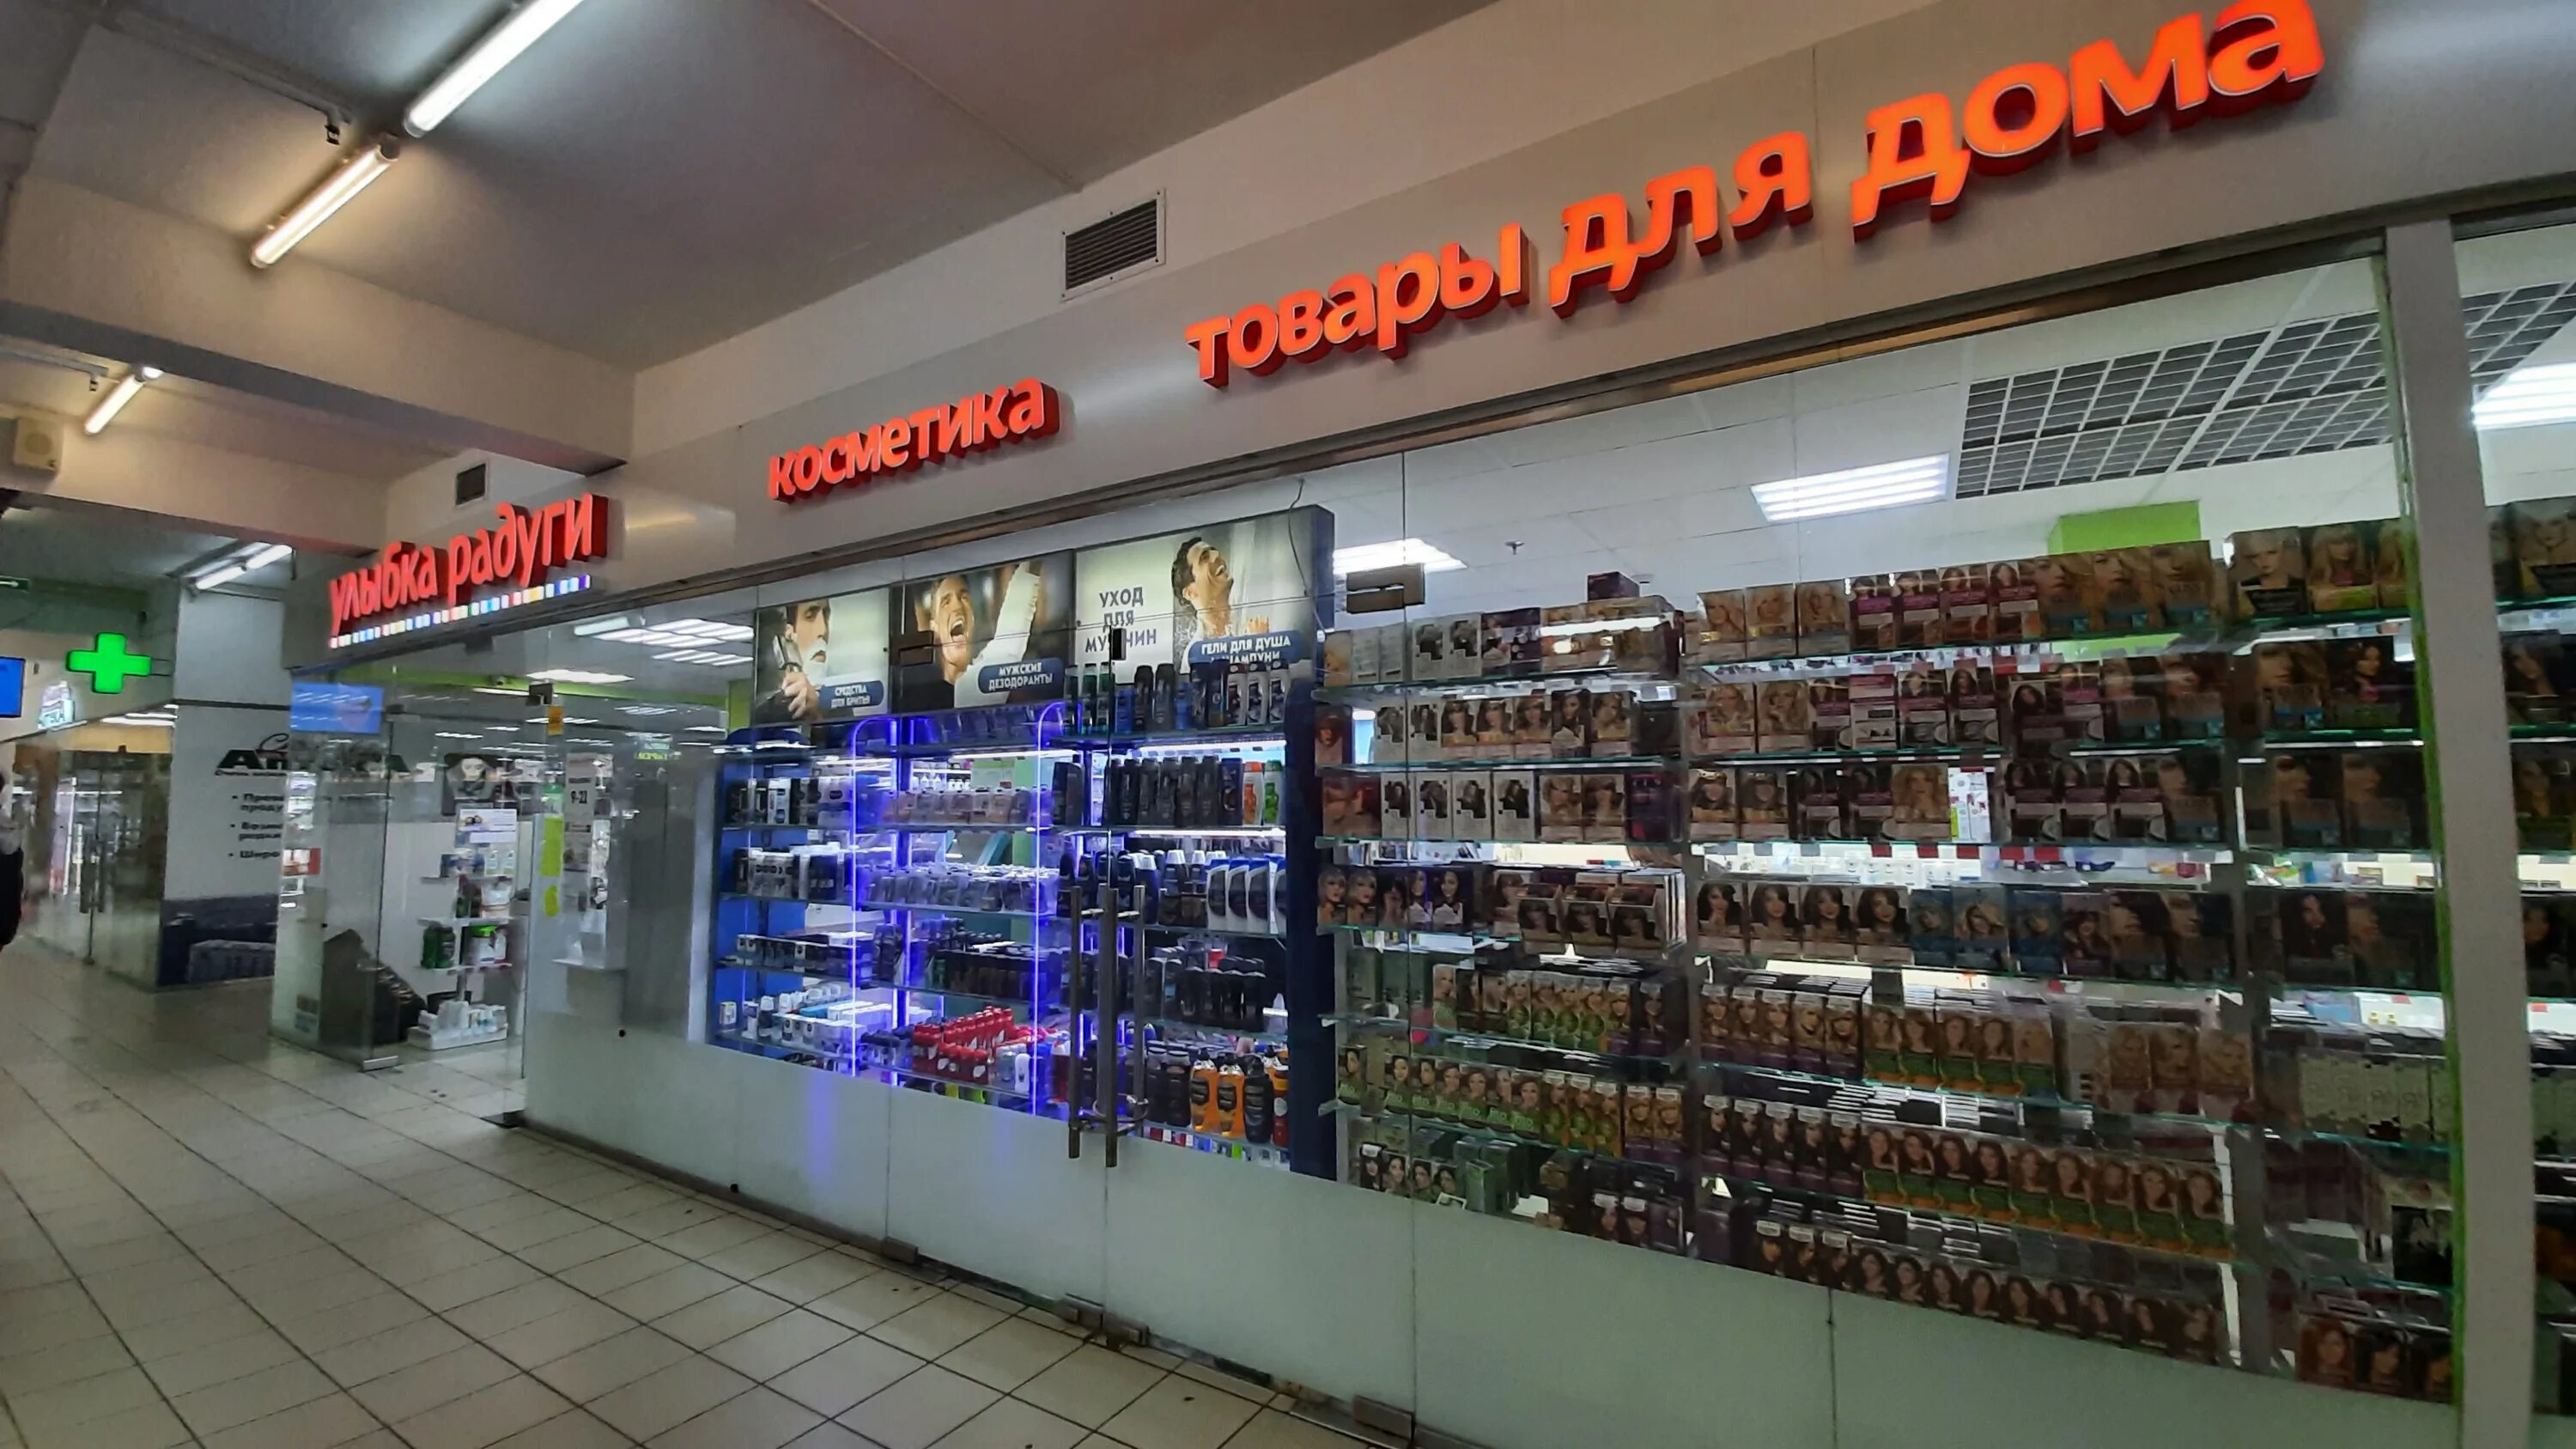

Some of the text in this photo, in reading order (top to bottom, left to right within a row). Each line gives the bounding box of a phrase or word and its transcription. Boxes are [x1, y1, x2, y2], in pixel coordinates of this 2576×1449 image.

[1184, 0, 2325, 380] товары для дома
[769, 377, 1046, 500] косметика
[329, 491, 594, 636] улыбка радуги
[1099, 587, 1144, 608] УХОД
[1103, 610, 1134, 633] ДЛЯ
[1085, 629, 1156, 653] МУЧИН
[1201, 636, 1291, 654] ГЕЛИ ДЛЯ ДУША
[999, 662, 1042, 676] МУЖСКИЕ
[988, 673, 1053, 691] ДЕЗОДОРАНТЫ
